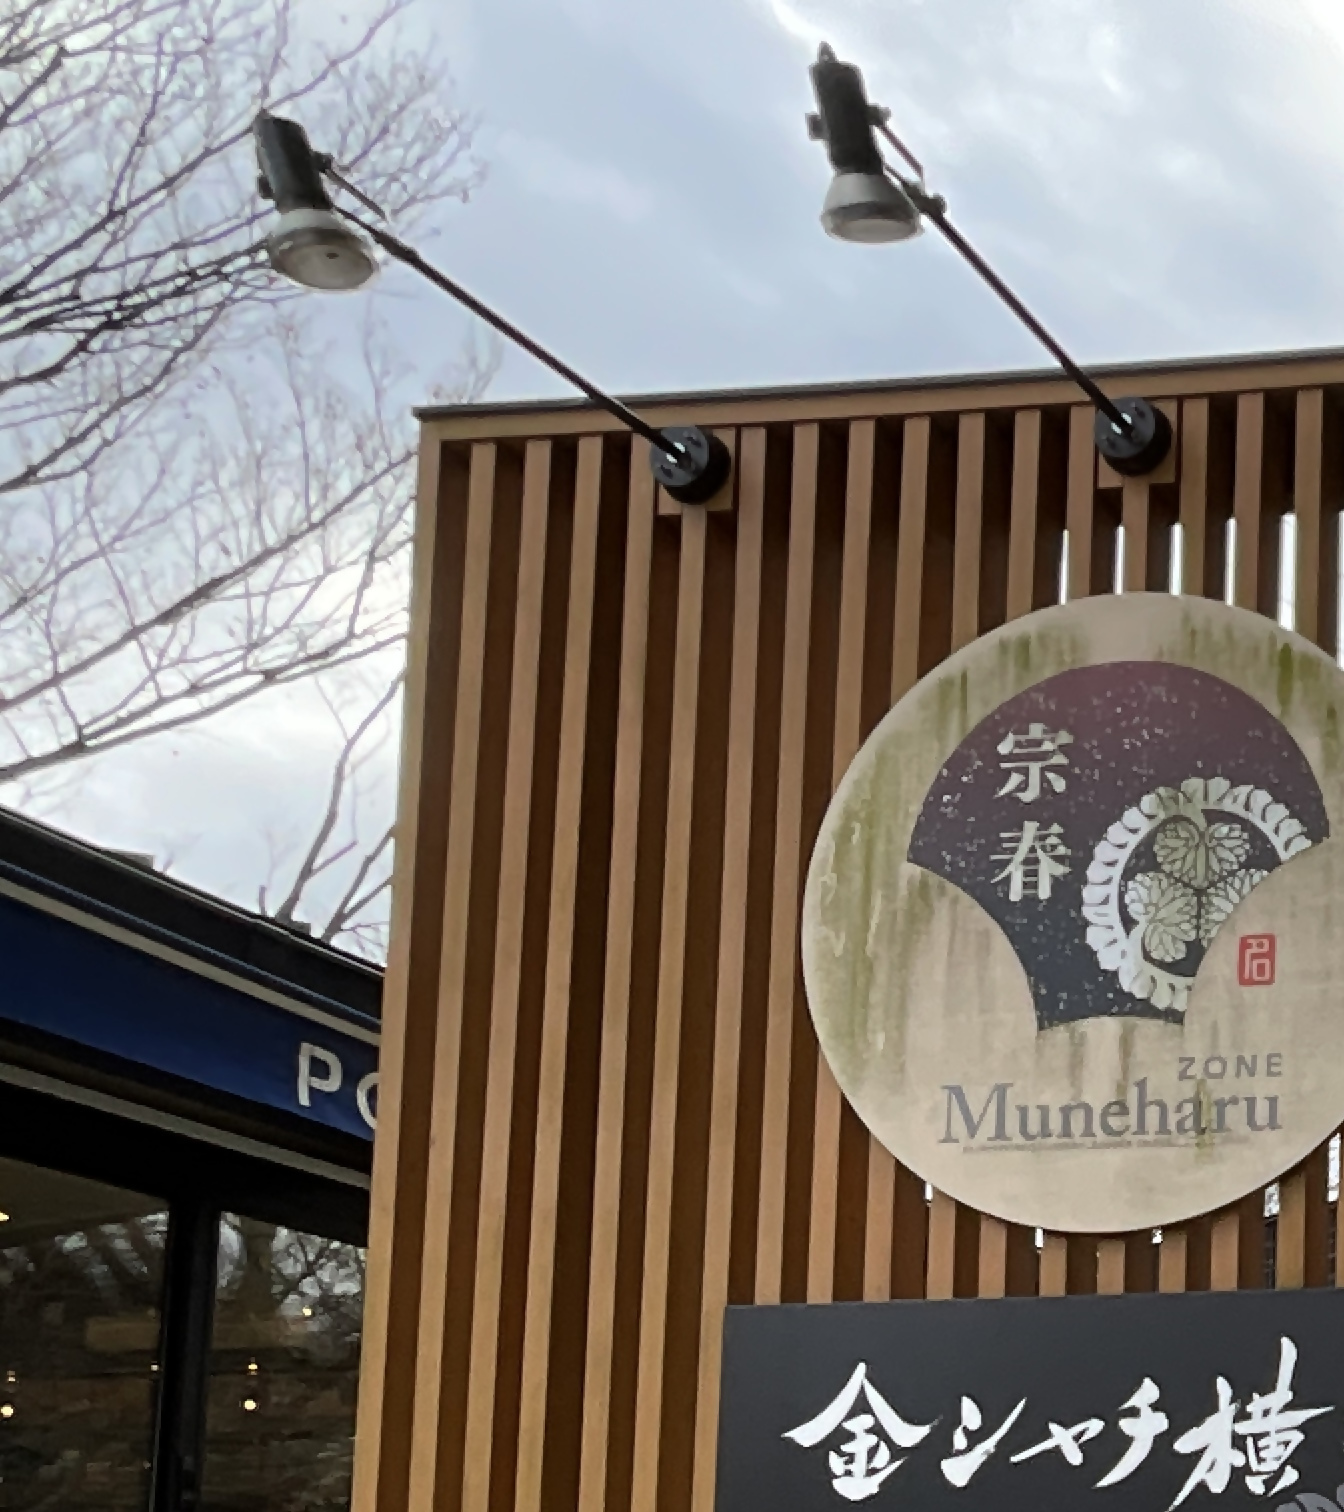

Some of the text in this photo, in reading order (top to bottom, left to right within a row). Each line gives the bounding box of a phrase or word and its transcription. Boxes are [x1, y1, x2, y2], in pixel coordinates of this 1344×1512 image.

[990, 723, 1073, 902] 宗春
[1179, 1052, 1283, 1081] ZONE
[939, 1078, 1282, 1143] Muneharu
